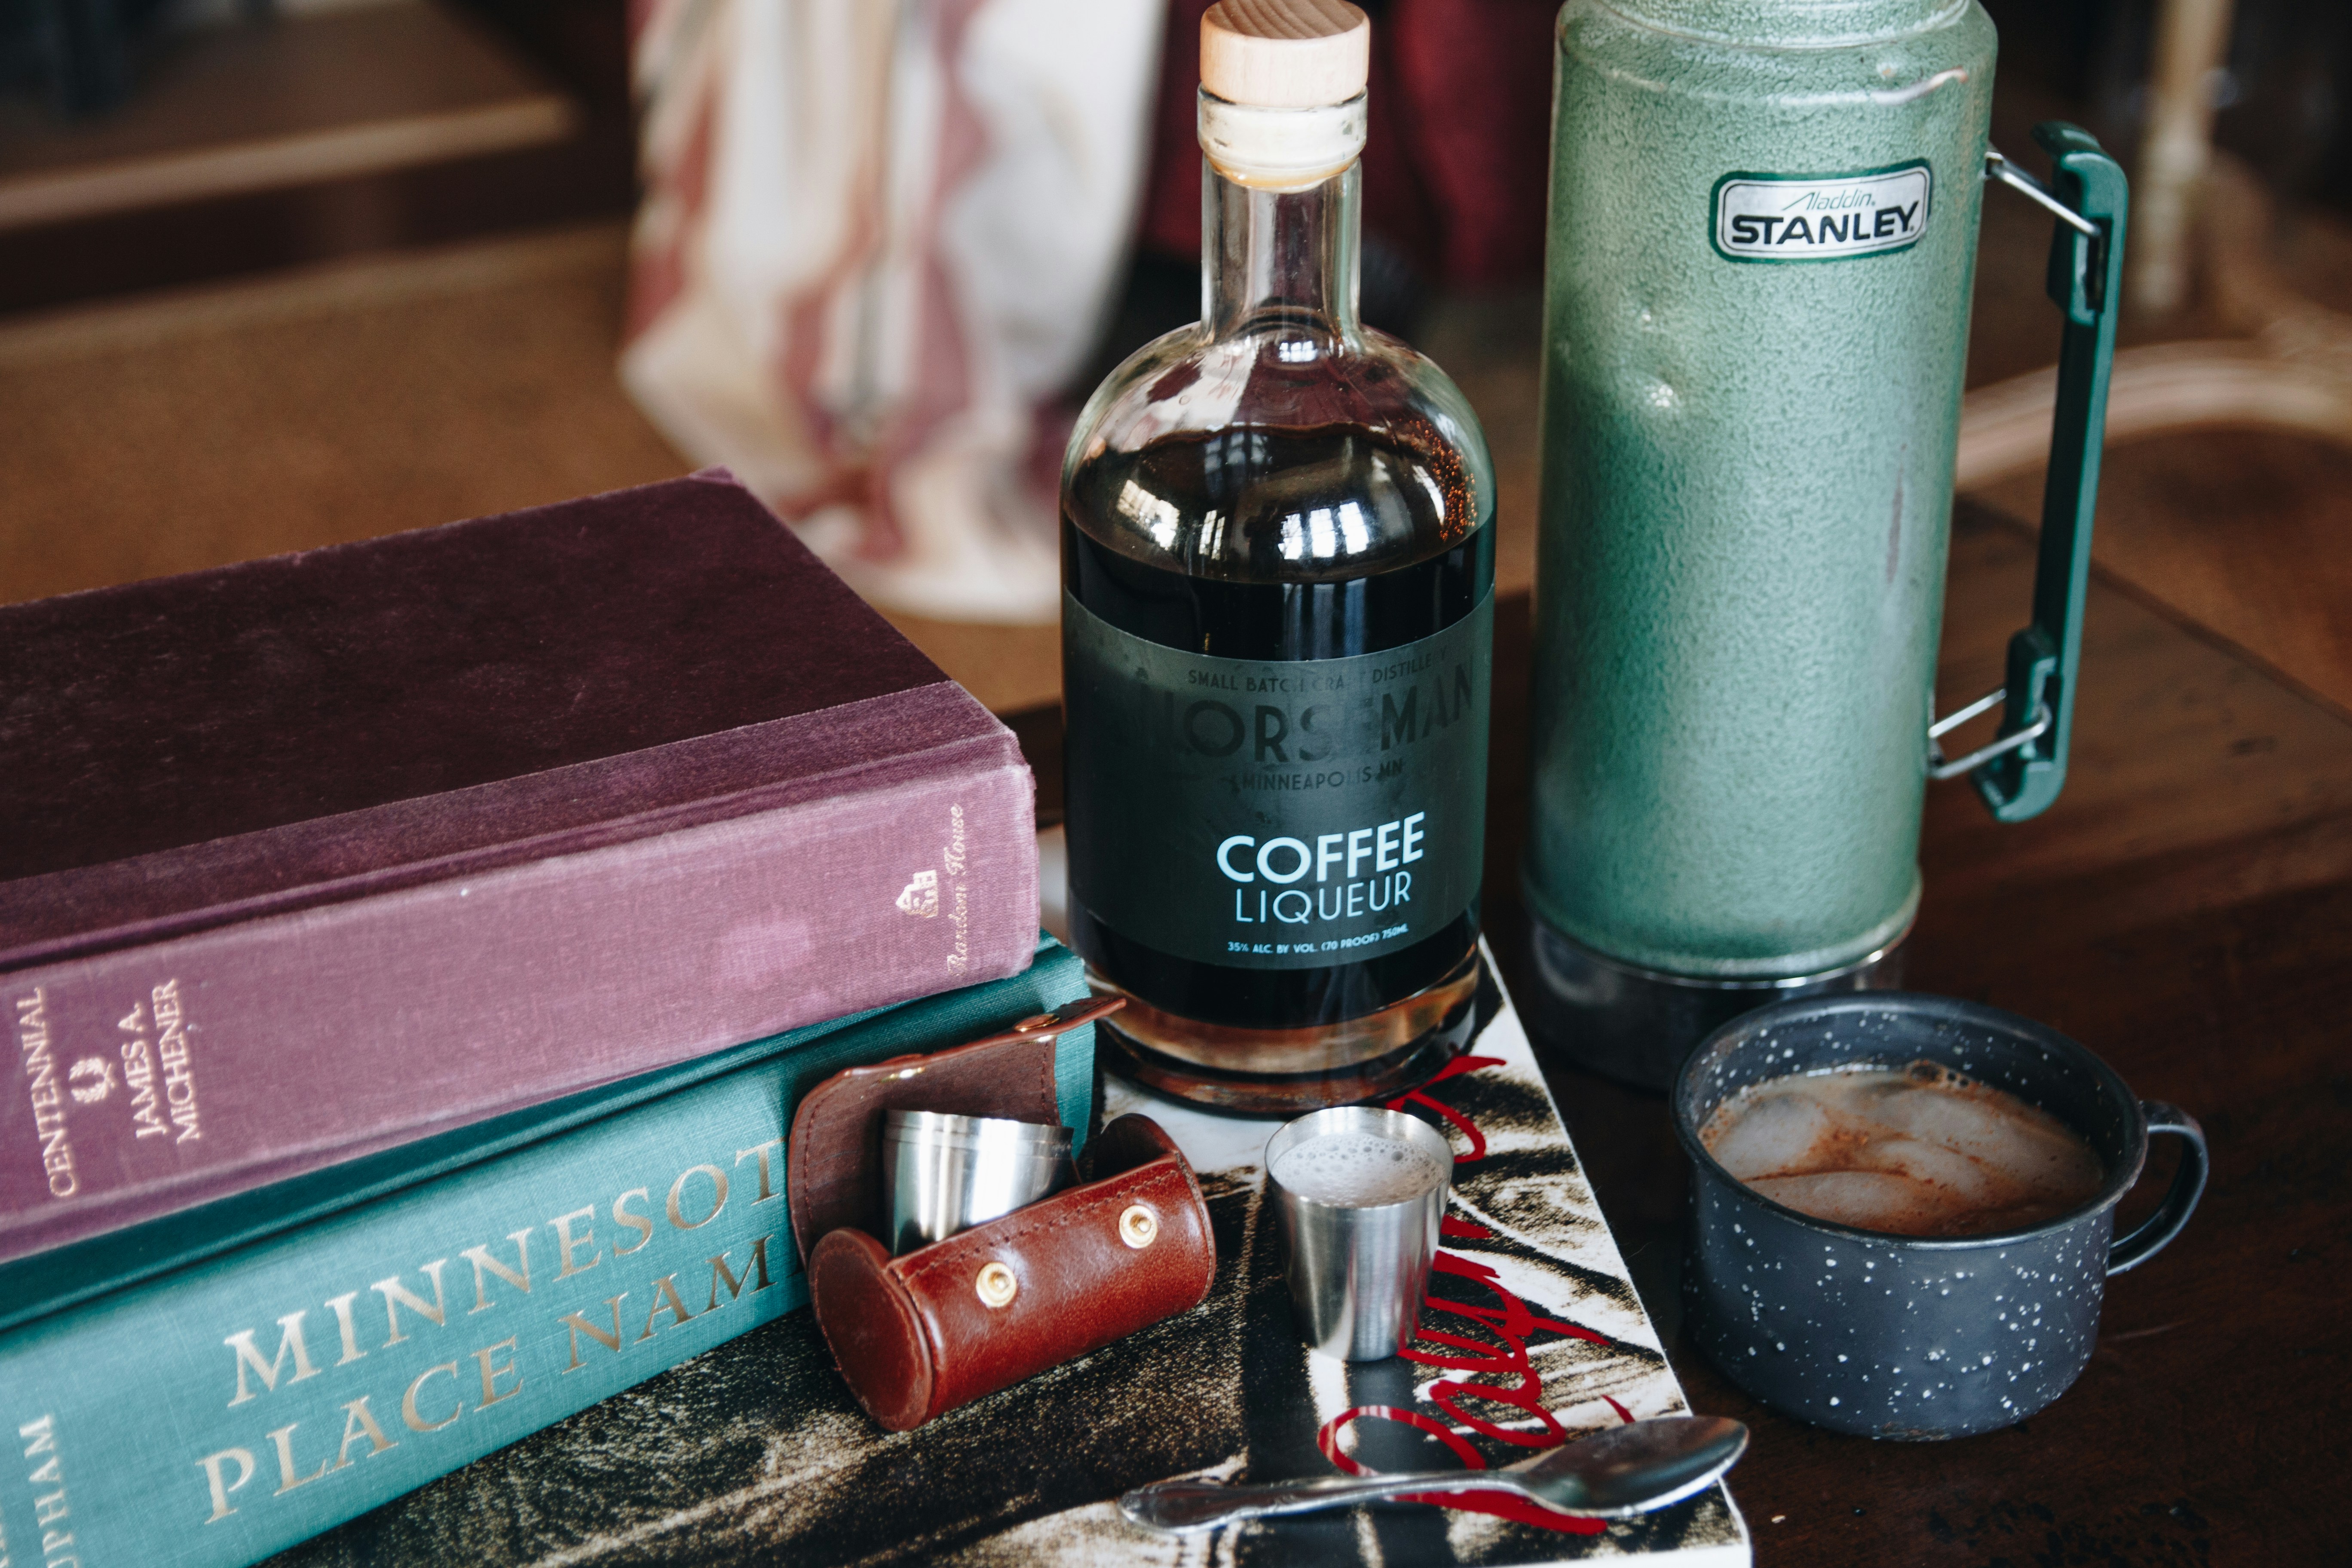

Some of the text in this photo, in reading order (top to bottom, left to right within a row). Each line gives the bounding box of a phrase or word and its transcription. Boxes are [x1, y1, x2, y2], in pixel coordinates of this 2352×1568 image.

[1732, 200, 1919, 245] STANLEY
[1188, 668, 1239, 691] SMALL
[1372, 645, 1447, 684] DISTILLEY
[1216, 811, 1425, 884] COFFEE
[1236, 871, 1412, 925] LIQUEUR
[1227, 941, 1250, 952] 35%
[1276, 943, 1289, 954] BY
[16, 987, 79, 1197] CENTENNIAL
[121, 1039, 169, 1139] JAMES
[151, 978, 201, 1145] MICHENER
[195, 1233, 805, 1525] PLACE NAM
